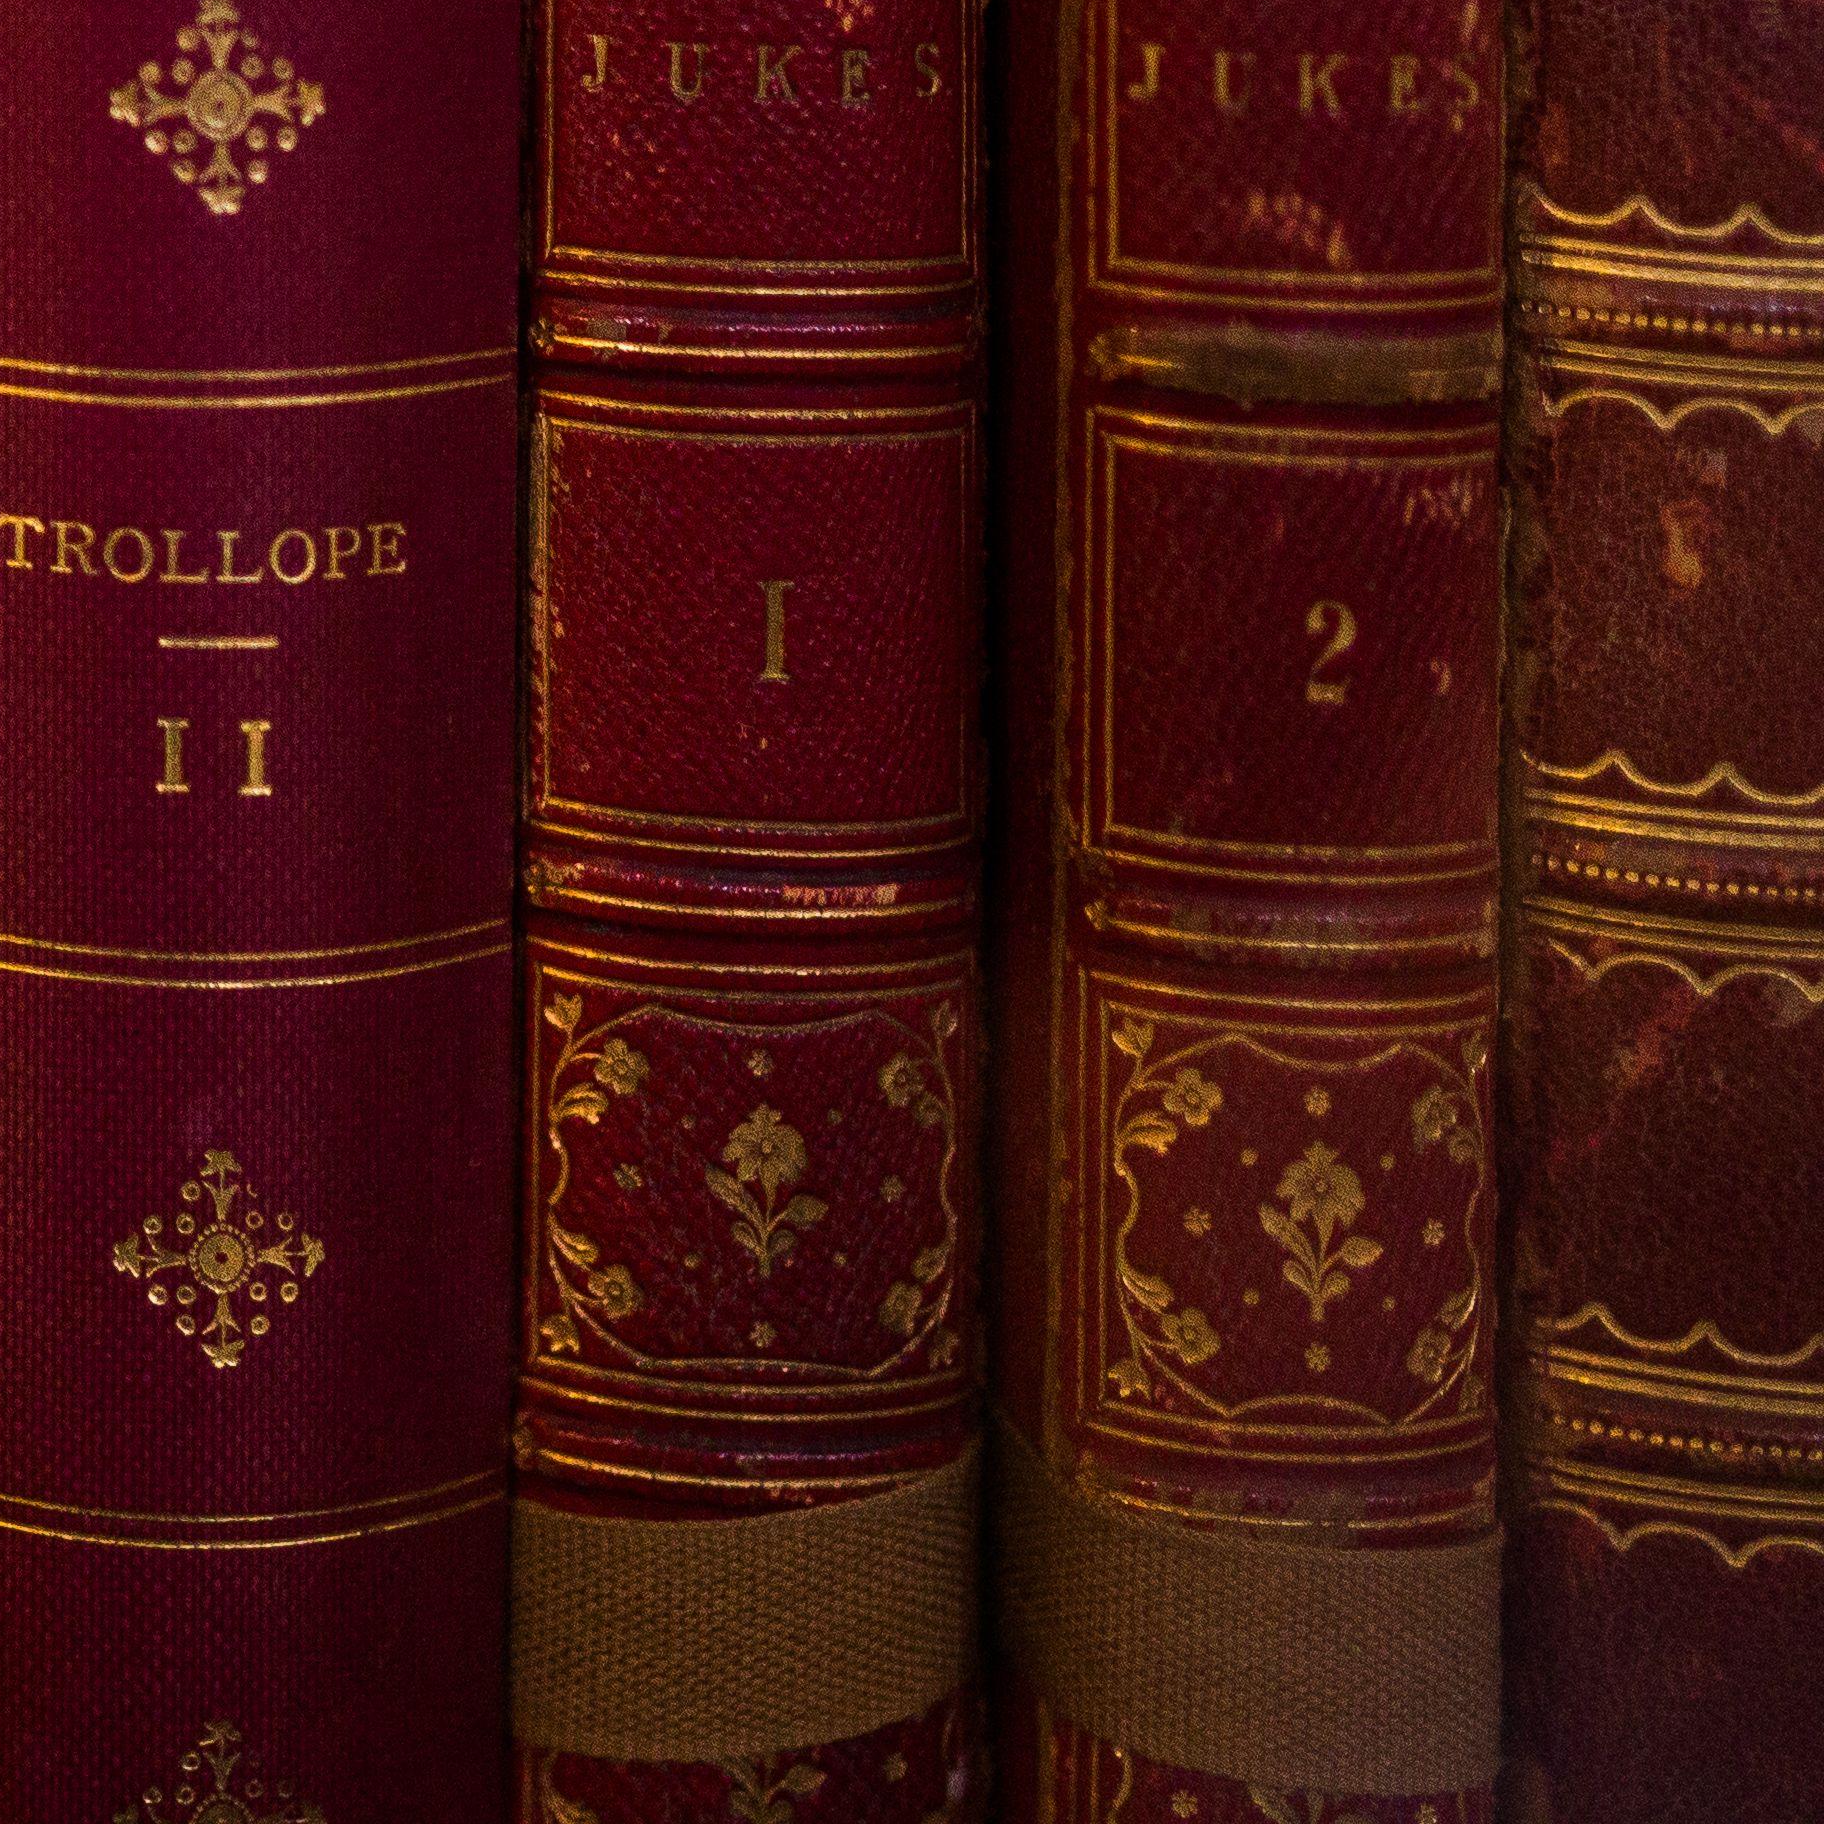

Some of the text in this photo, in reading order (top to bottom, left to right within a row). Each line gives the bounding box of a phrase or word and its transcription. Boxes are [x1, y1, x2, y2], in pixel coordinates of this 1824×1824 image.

[581, 33, 943, 108] JUKES
[1127, 43, 1480, 116] JUKES
[1305, 599, 1357, 706] 2
